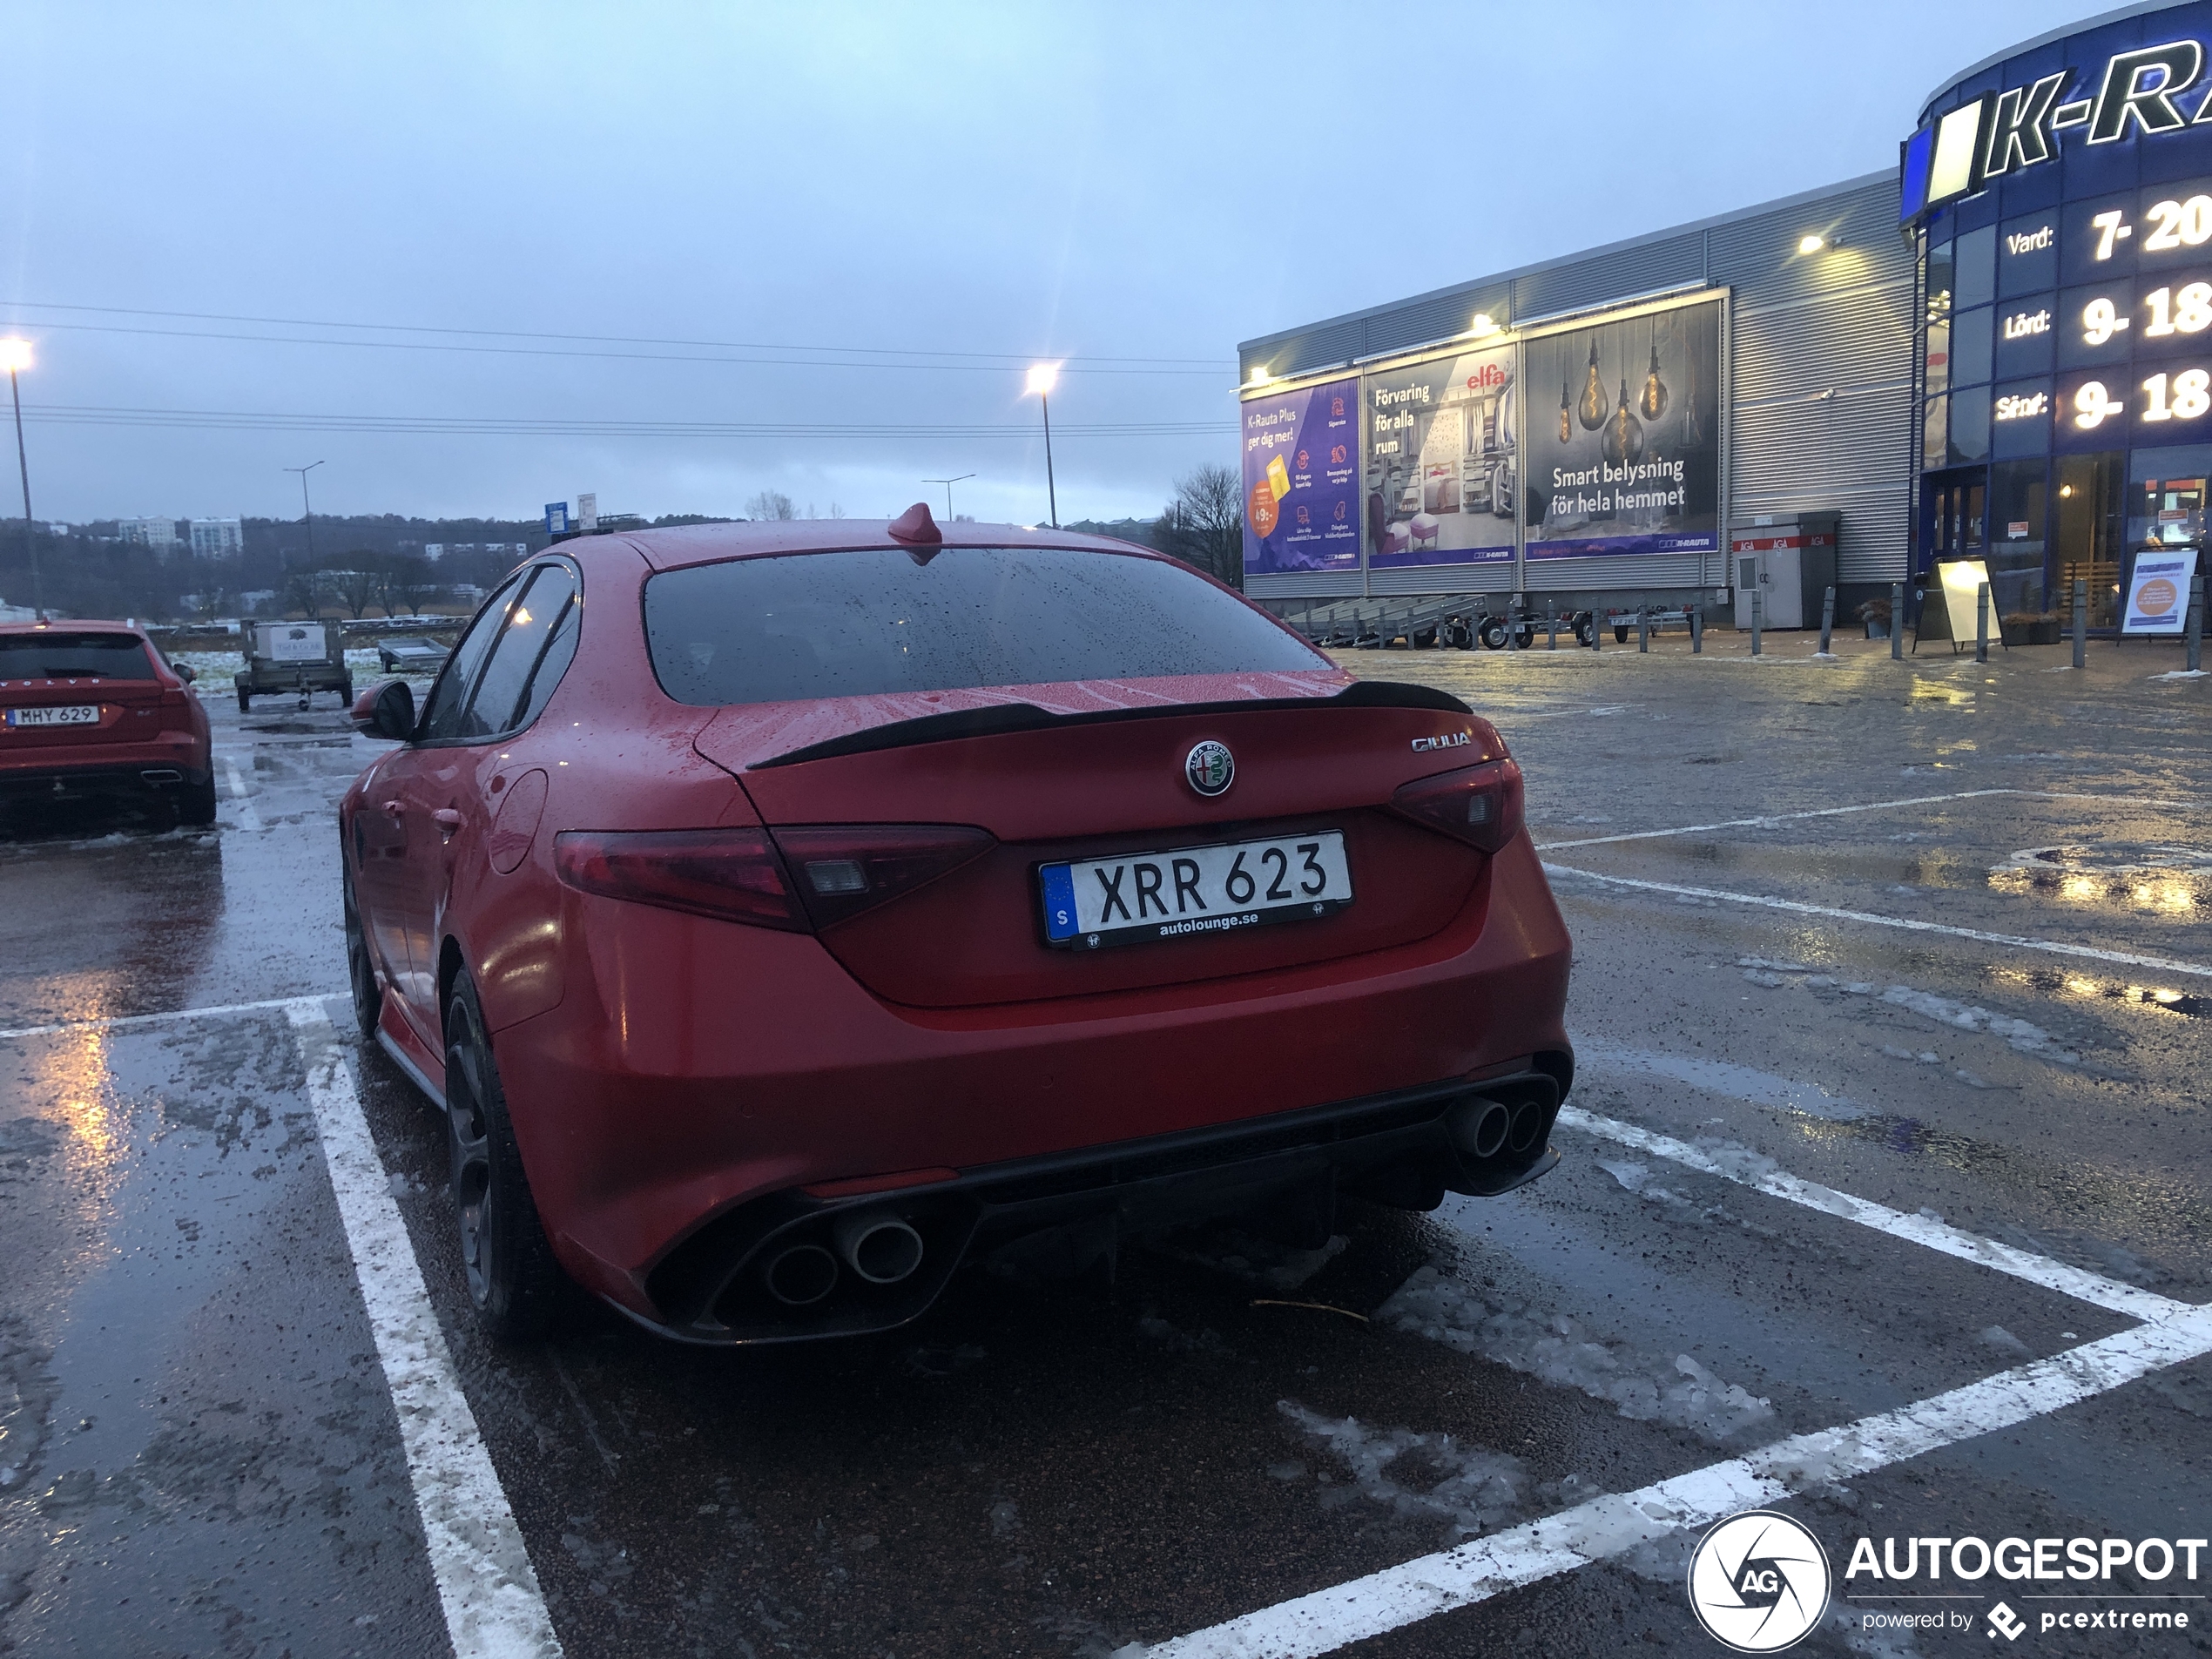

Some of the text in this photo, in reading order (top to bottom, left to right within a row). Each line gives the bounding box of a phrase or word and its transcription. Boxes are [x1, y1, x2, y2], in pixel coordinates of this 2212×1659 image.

[1984, 39, 2212, 178] K-R
[2006, 226, 2054, 254] Vard:
[2146, 195, 2212, 251] 20
[2006, 310, 2051, 339] Lörd:
[2146, 281, 2212, 337] 18
[1467, 364, 1505, 389] elfa
[1376, 383, 1429, 407] Förvaring
[2142, 368, 2210, 421] 18
[1248, 408, 1296, 428] K-Rauta Plus
[1376, 409, 1414, 432] för alla
[1248, 427, 1293, 451] ger dig mer!
[1376, 440, 1398, 455] rum
[1553, 457, 1684, 488] Smart belysning
[1552, 486, 1684, 515] för hela hemmet
[1740, 536, 1824, 550] AGA AGA AGA
[21, 709, 53, 723] MHY
[59, 707, 91, 721] 629
[1412, 732, 1471, 752] GIULIA
[1190, 745, 1232, 770] ALFA ROMEO
[1094, 843, 1326, 923] XRR 623
[1056, 910, 1069, 926] S
[1159, 914, 1258, 936] autolounge.se
